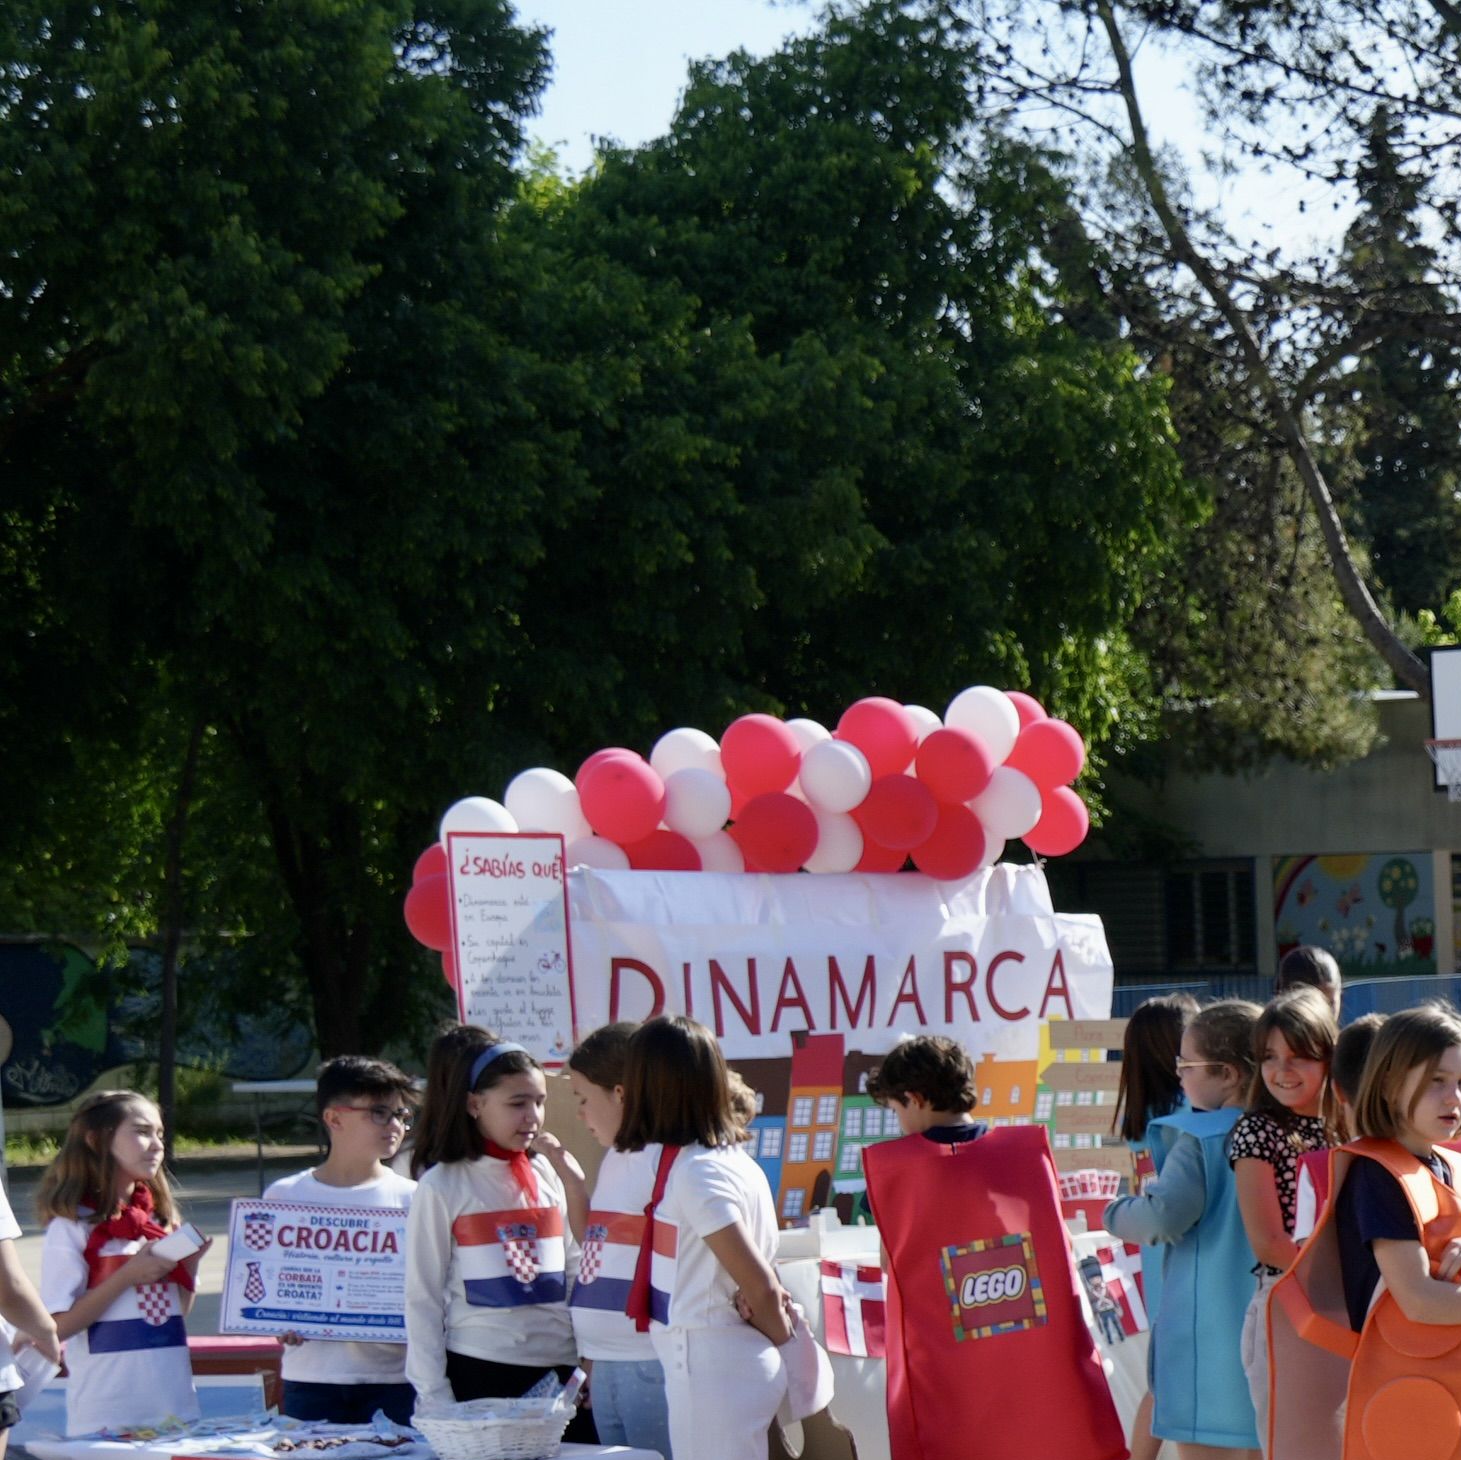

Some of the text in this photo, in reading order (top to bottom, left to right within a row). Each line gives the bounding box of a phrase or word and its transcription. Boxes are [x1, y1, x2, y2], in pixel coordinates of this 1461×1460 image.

[460, 848, 526, 878] ¿SABÍAS
[608, 949, 1075, 1037] DINAMARCA
[310, 1215, 371, 1229] DESCUBRE
[277, 1225, 398, 1254] CROACIA
[278, 1272, 323, 1284] CORBATA
[962, 1268, 1023, 1306] LEGO
[277, 1288, 323, 1301] CROATA?
